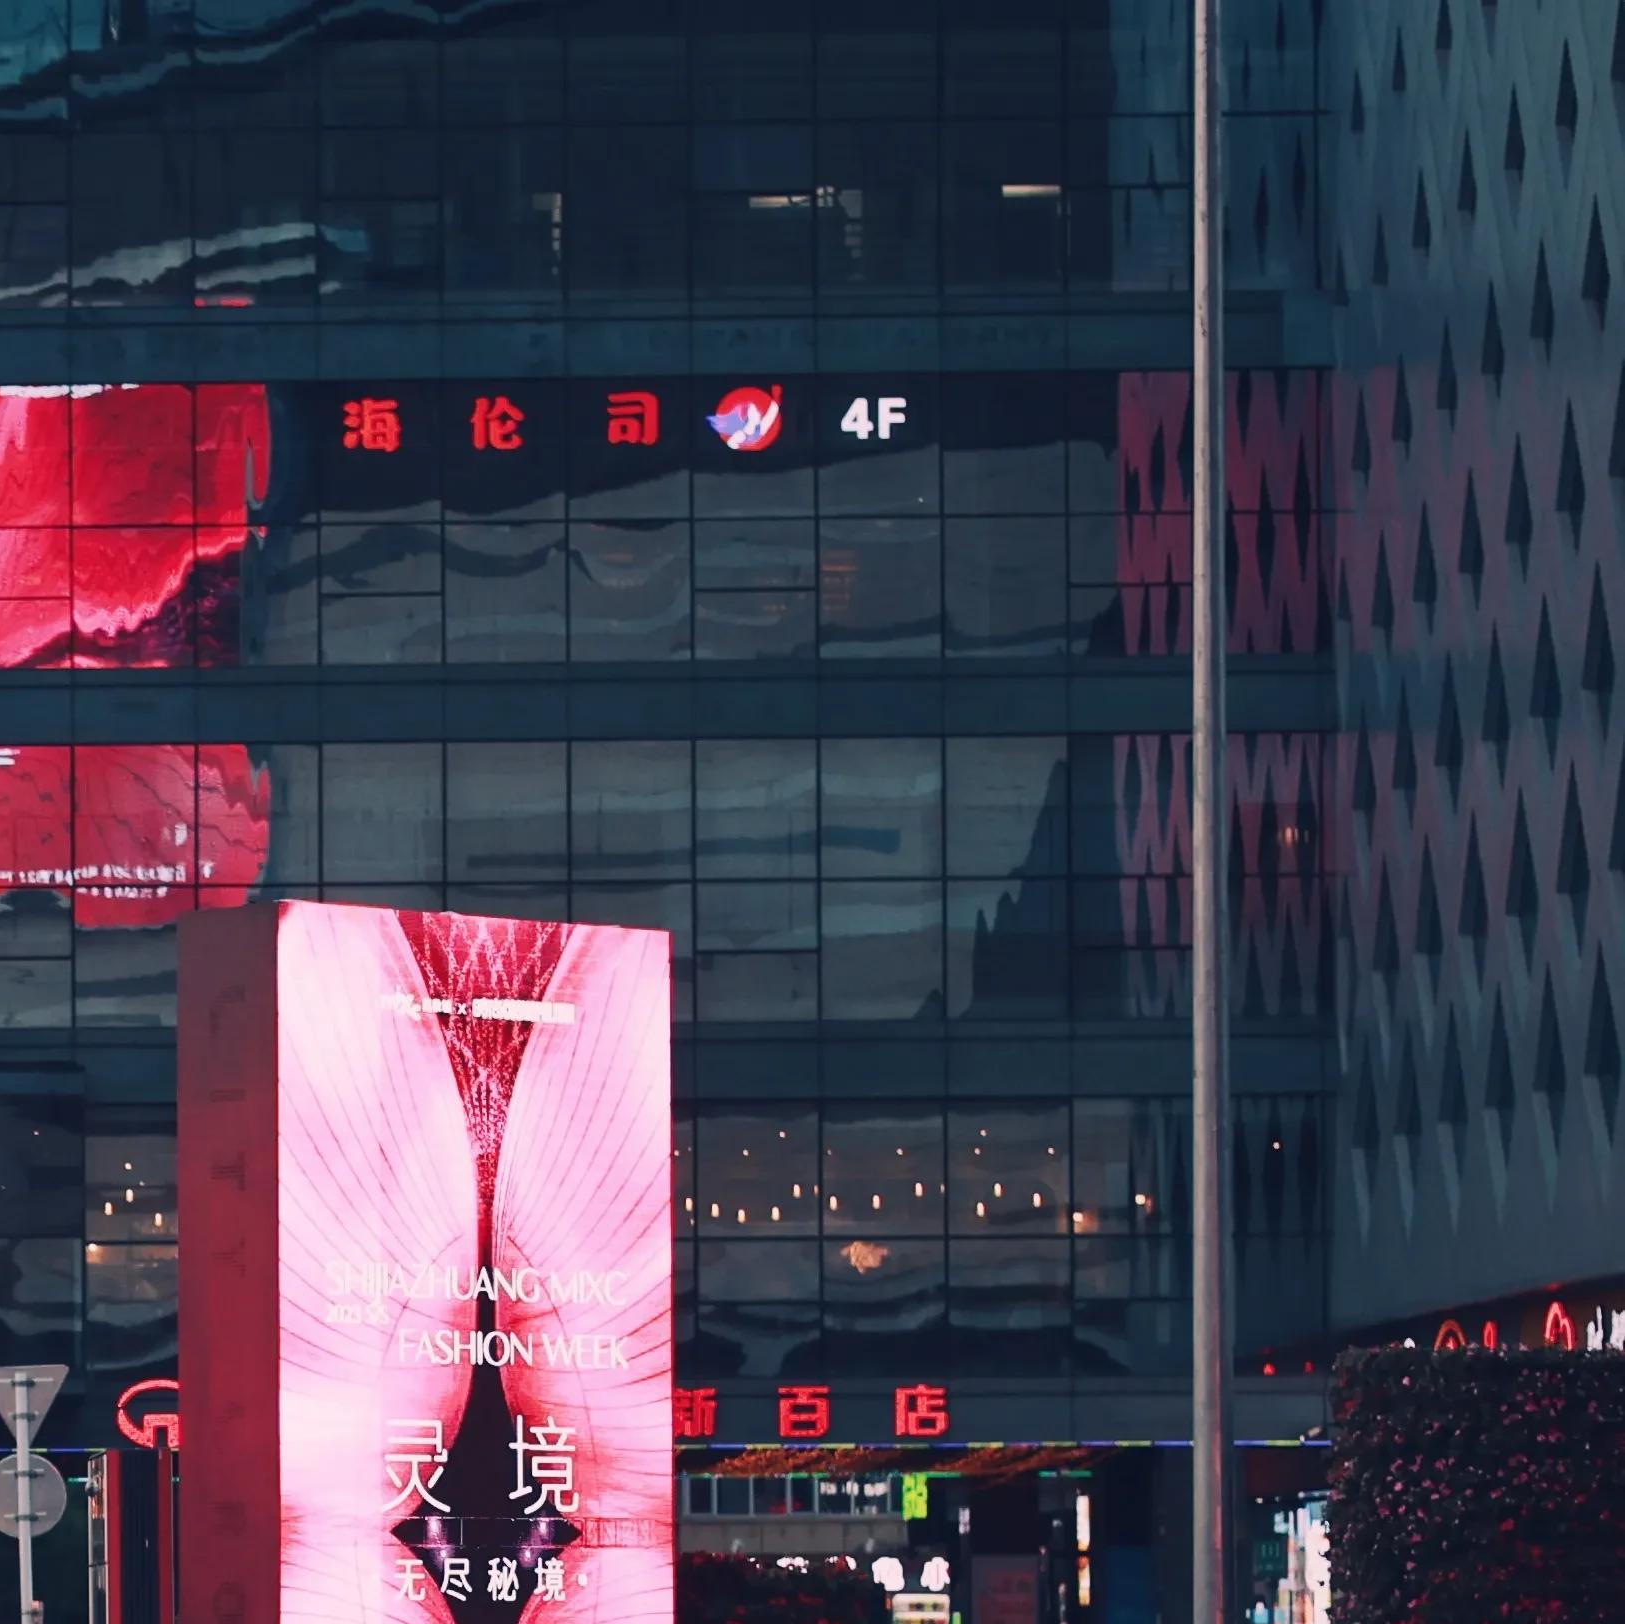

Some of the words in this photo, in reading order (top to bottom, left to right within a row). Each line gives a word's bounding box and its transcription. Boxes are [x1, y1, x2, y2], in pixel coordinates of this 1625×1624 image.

[343, 391, 661, 454] 海伦司
[840, 396, 907, 441] 4F
[550, 1270, 628, 1306] MIXC
[398, 1330, 533, 1368] FASHION
[544, 1333, 630, 1370] WEEK
[674, 1384, 948, 1437] 新百店
[383, 1415, 579, 1515] 灵境
[392, 1558, 568, 1604] 无尽秘境
